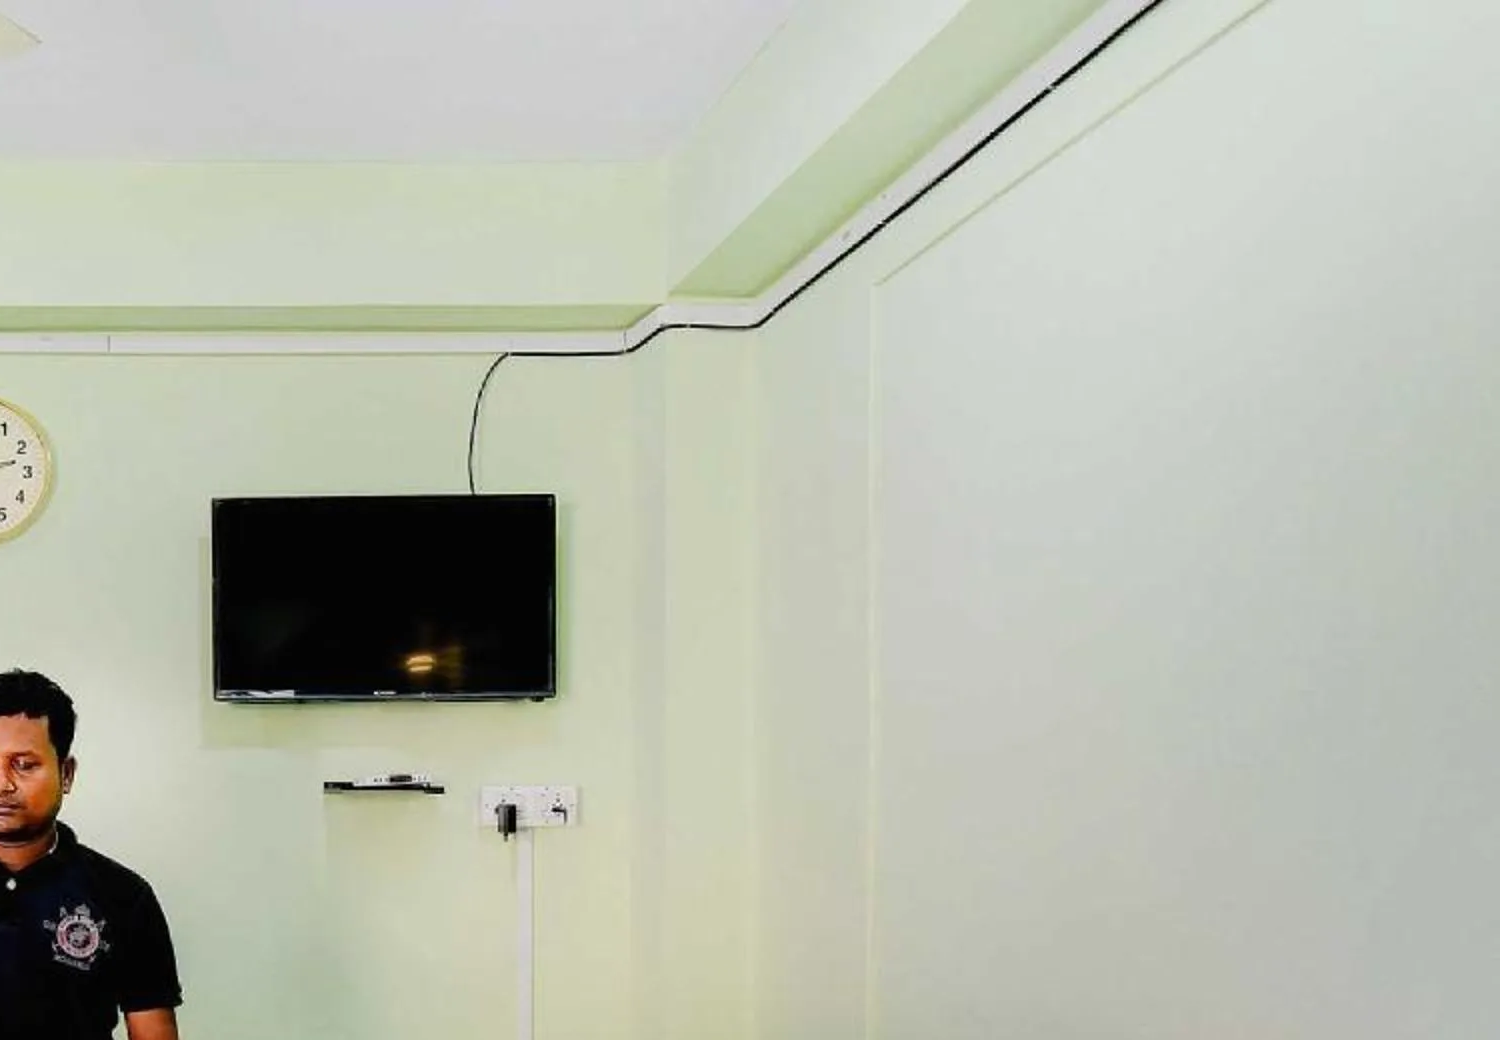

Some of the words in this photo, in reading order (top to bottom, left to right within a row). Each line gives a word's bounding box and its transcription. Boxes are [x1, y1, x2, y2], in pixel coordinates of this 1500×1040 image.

[0, 422, 8, 436] 1
[16, 440, 27, 454] 2
[22, 465, 33, 479] 3
[15, 489, 25, 504] 4
